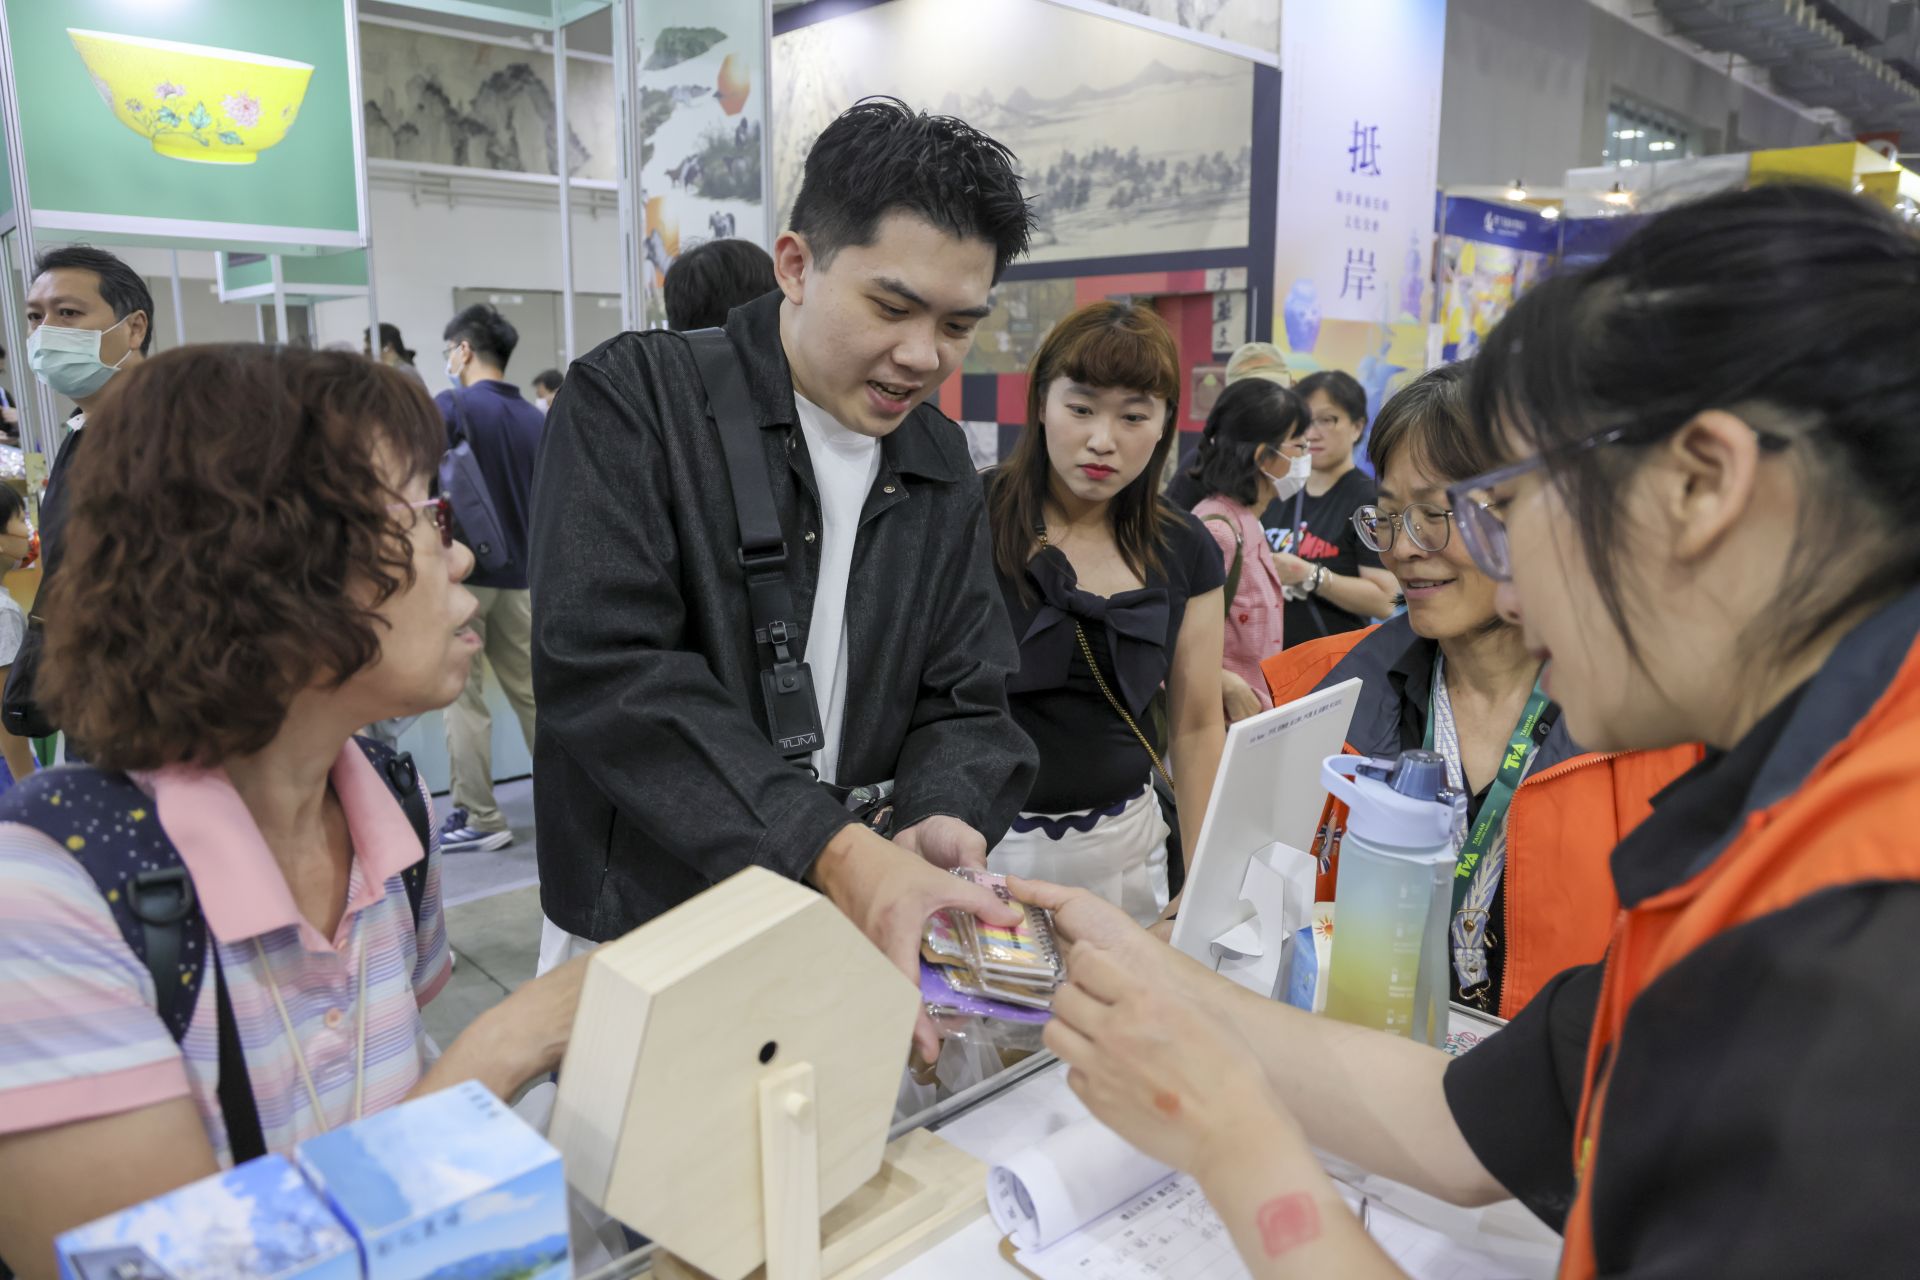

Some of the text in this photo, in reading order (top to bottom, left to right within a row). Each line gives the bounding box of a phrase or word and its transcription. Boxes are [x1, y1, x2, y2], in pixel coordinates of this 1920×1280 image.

[1340, 121, 1381, 300] 抵 岸
[1519, 714, 1534, 737] TAIWAN
[779, 732, 817, 748] TUMI
[1472, 822, 1486, 846] TAIWAN
